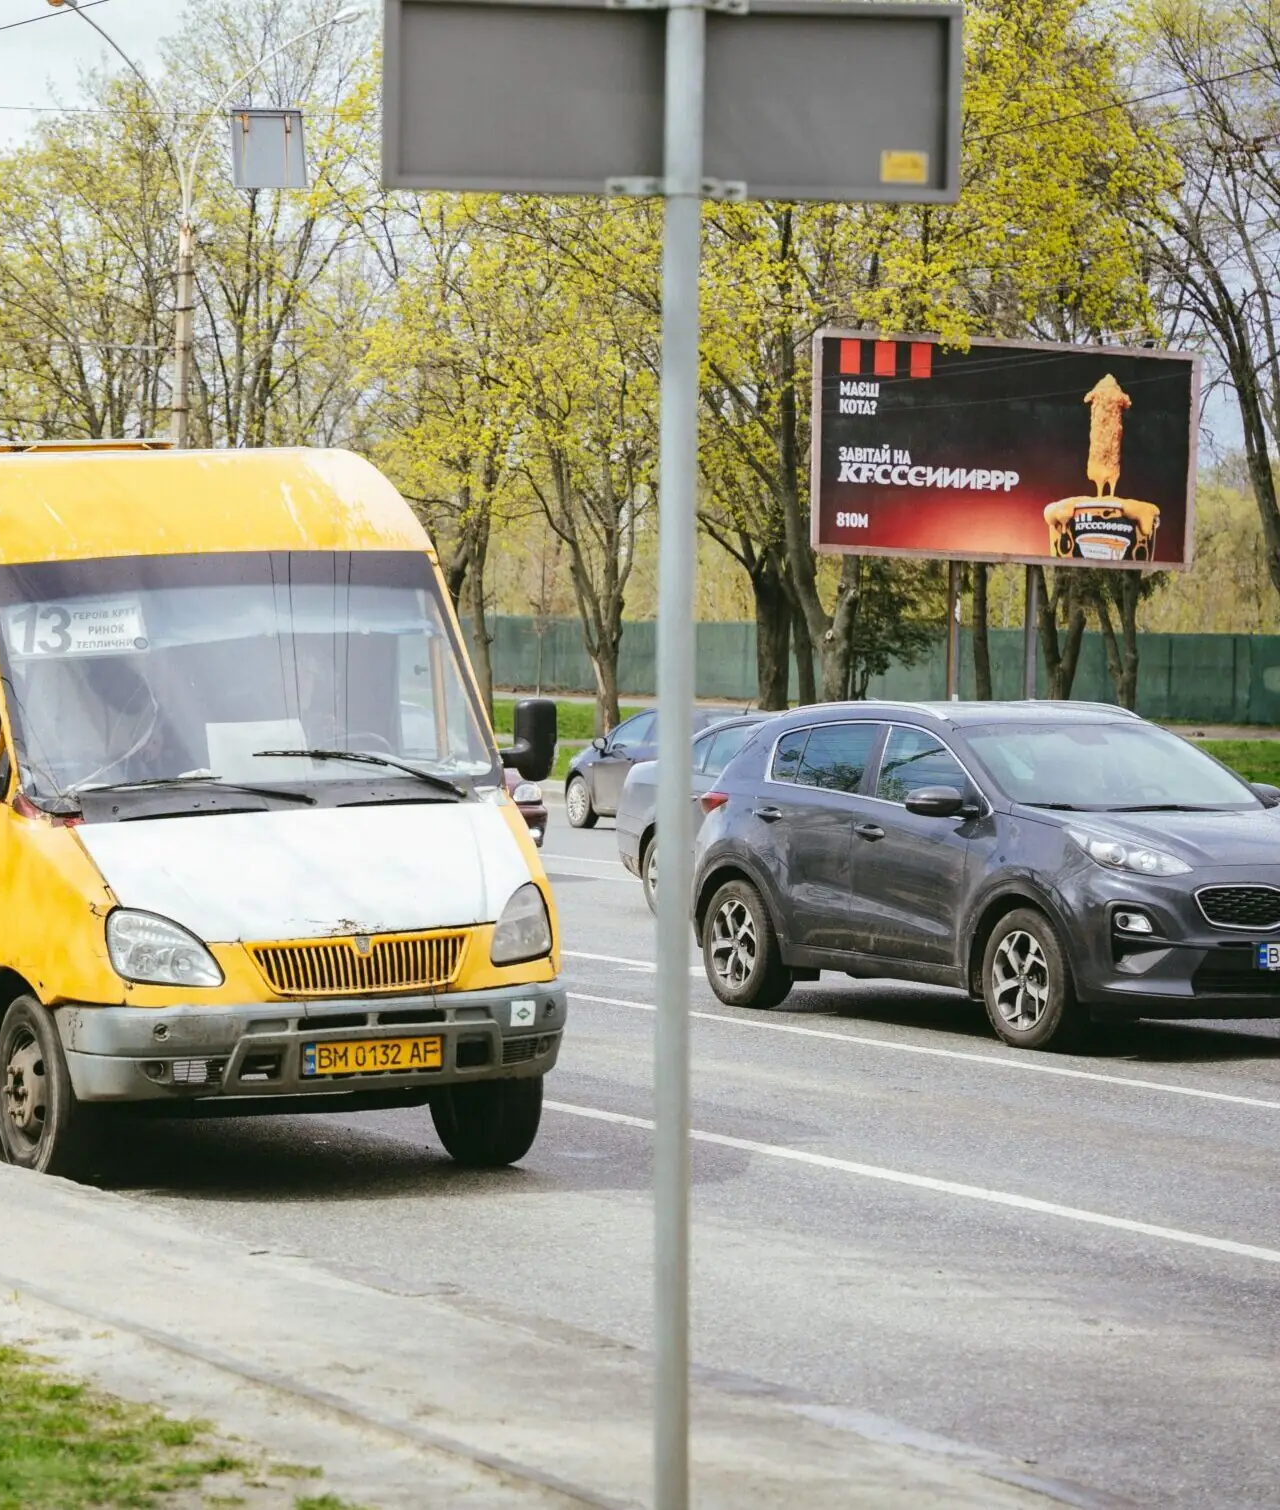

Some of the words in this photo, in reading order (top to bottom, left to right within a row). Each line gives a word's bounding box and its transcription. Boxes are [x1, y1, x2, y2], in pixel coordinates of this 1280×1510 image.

[840, 381, 880, 398] МАЄШ
[839, 398, 878, 415] КОТА?
[838, 444, 891, 463] ЗАВІТАЙ
[893, 449, 912, 465] НА
[72, 610, 110, 621] ГЕРОЇВ
[13, 603, 72, 653] 13
[88, 623, 125, 635] РИНОК
[76, 638, 135, 649] ТЕПЛИЧНИ
[318, 1046, 349, 1069] BM
[355, 1043, 402, 1067] 0132
